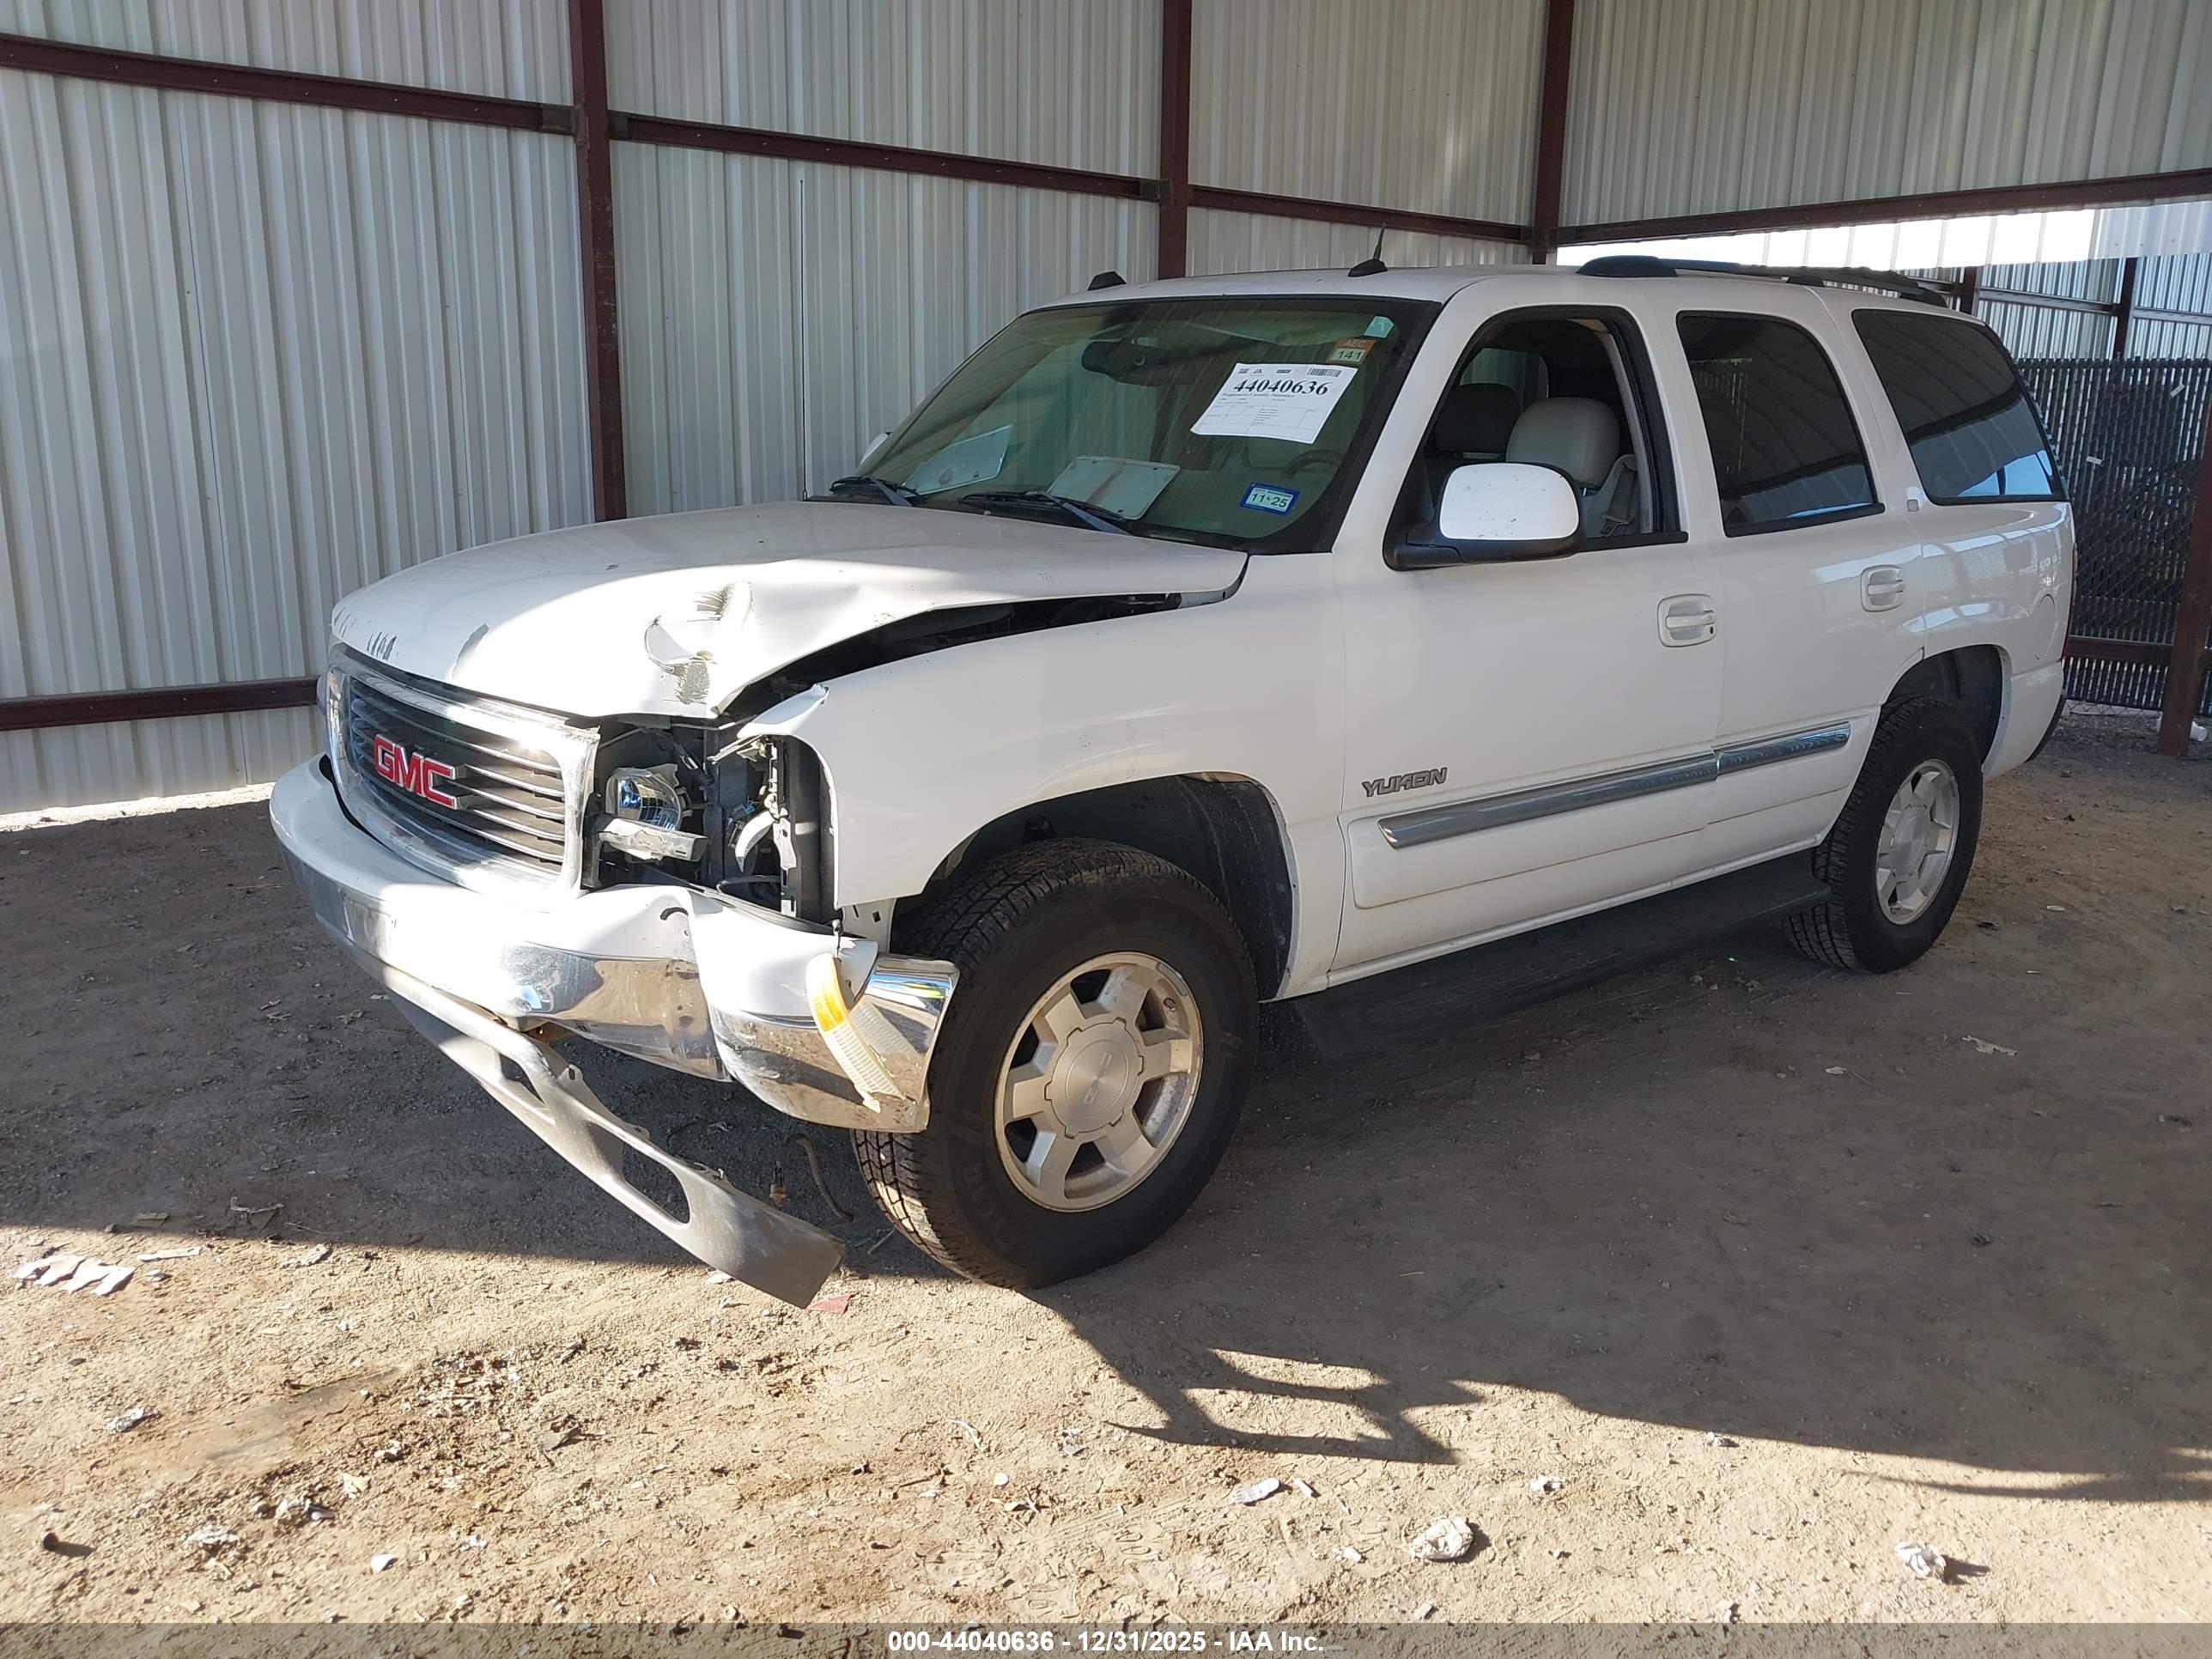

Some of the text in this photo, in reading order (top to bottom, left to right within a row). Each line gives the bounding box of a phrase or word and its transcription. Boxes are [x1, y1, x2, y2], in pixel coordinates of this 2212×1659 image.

[1338, 350, 1362, 360] 141
[1233, 379, 1333, 396] 44040636
[373, 732, 458, 811] GMC
[1362, 767, 1448, 797] YUKON
